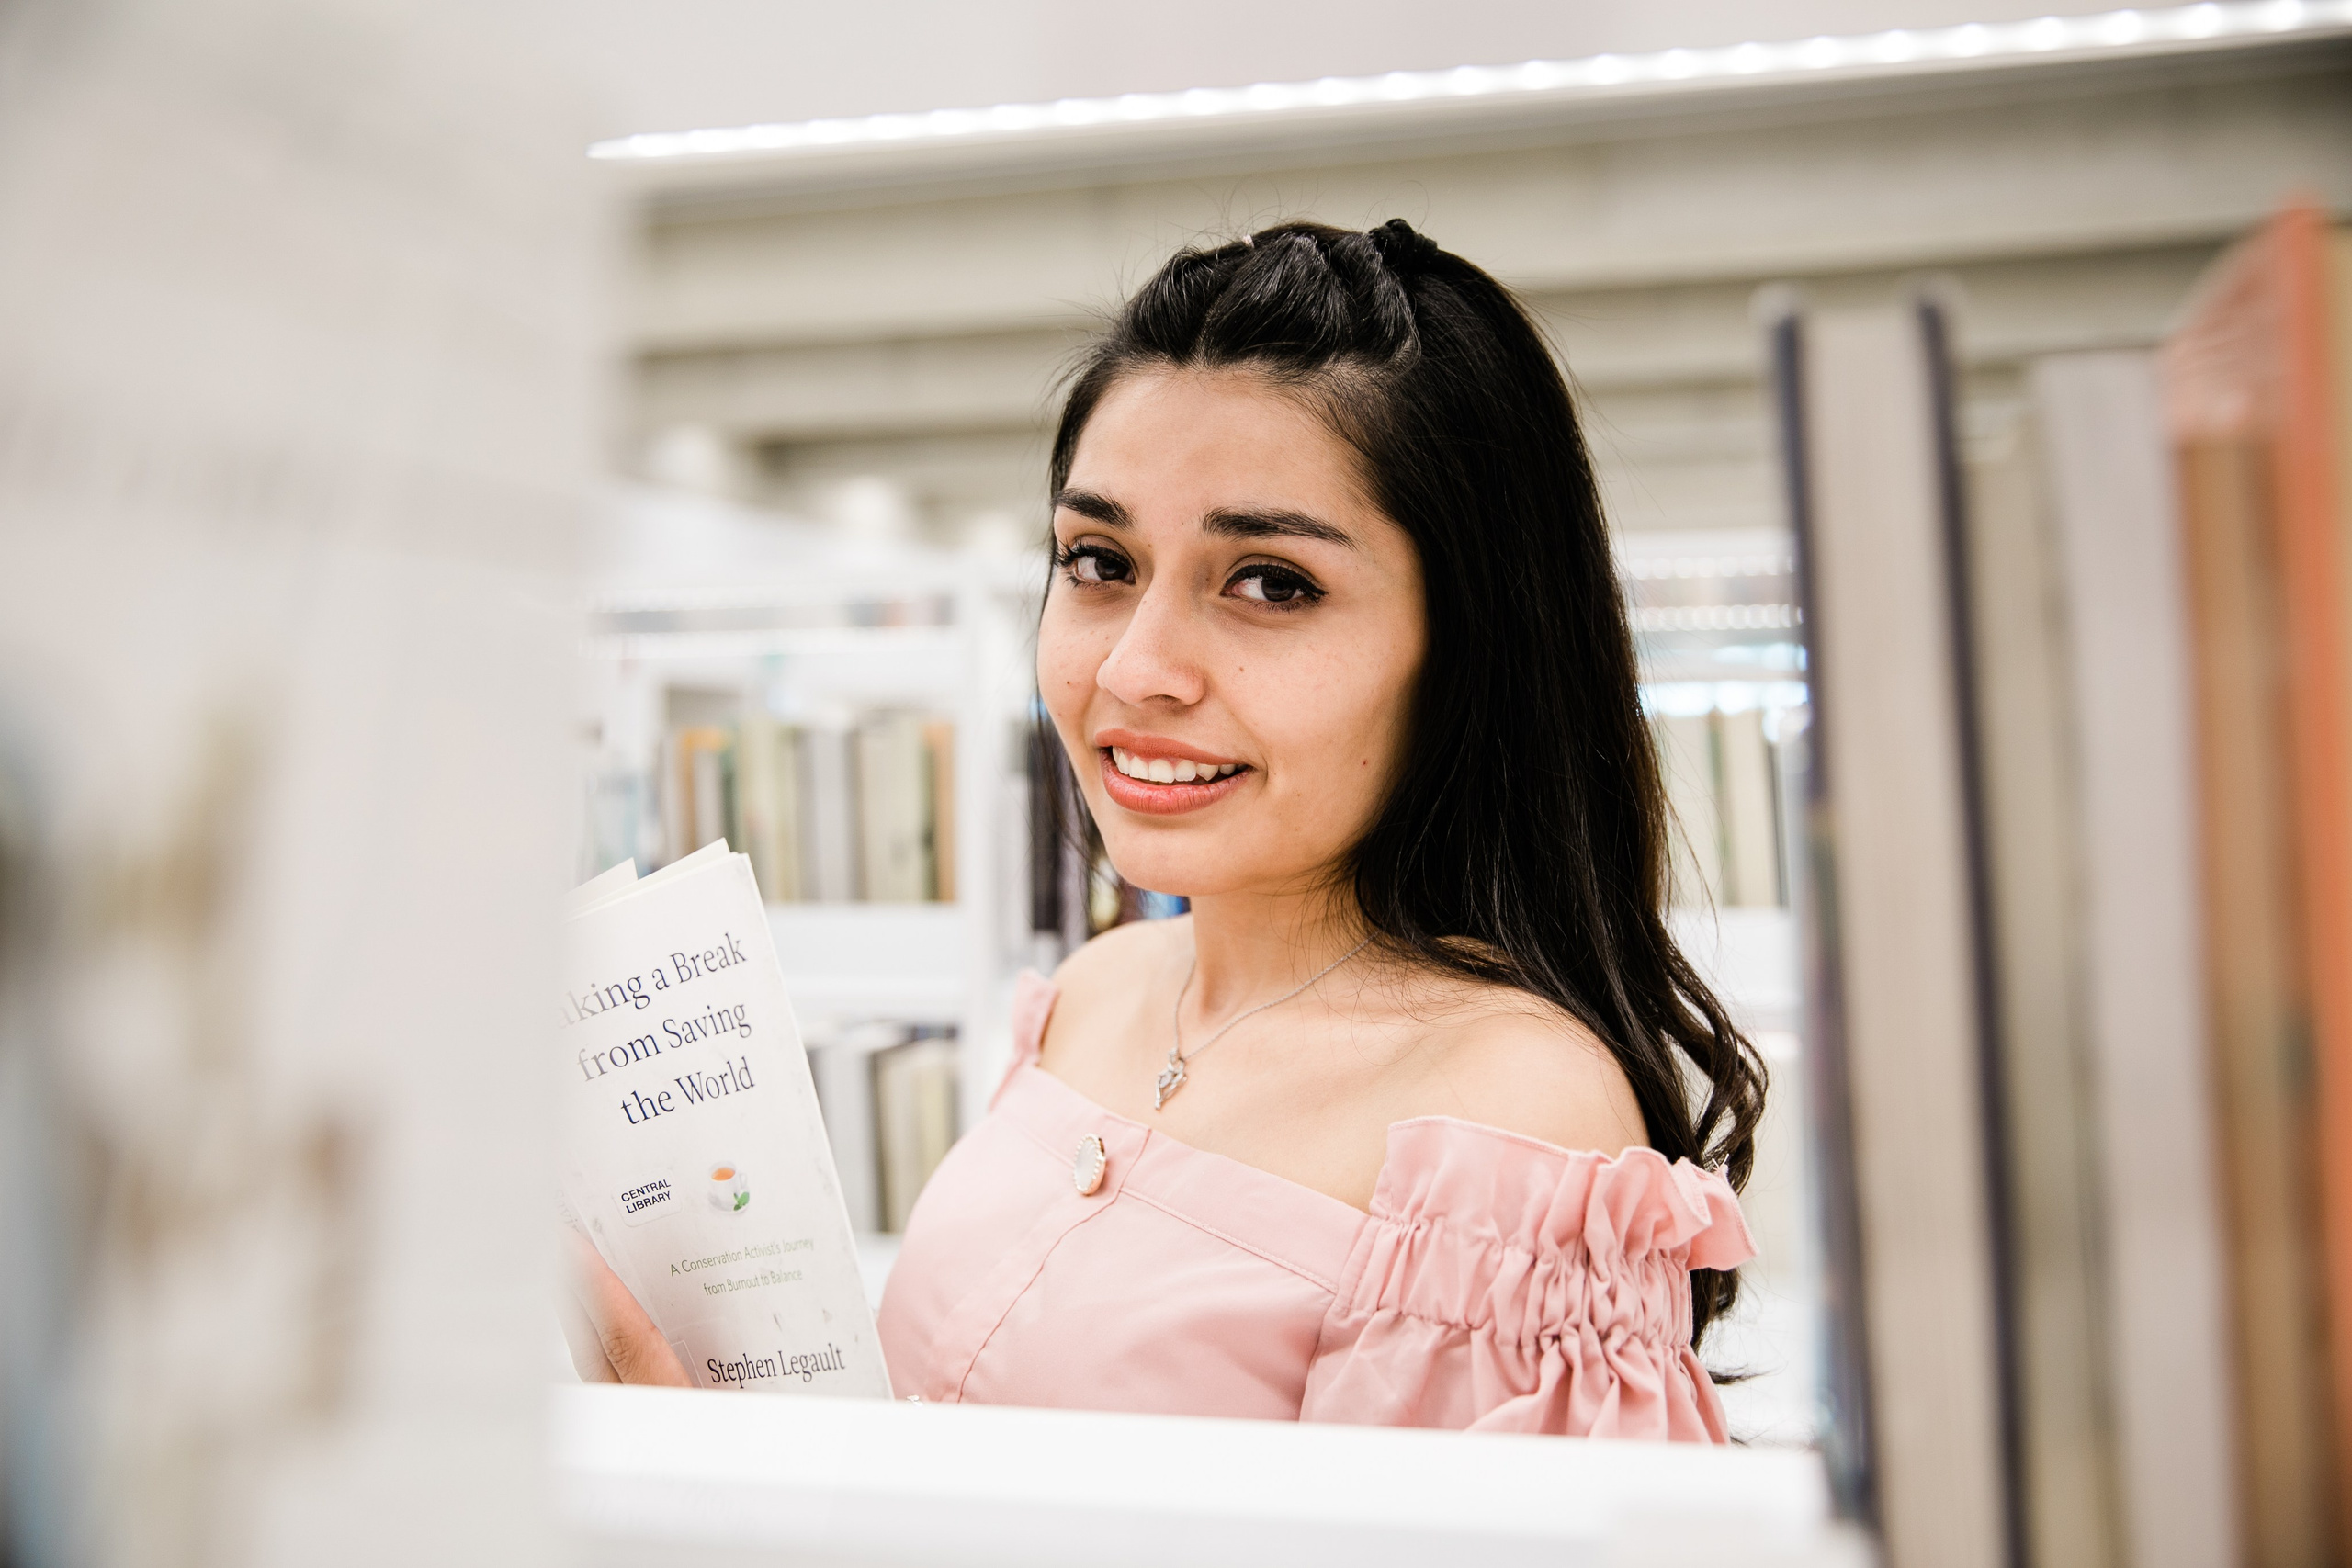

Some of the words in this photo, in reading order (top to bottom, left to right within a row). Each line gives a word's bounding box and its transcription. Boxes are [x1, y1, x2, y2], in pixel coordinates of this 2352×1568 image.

[651, 968, 670, 991] a
[669, 932, 747, 984] Break
[576, 1033, 662, 1082] from
[662, 1004, 752, 1048] Saving
[620, 1090, 675, 1125] the
[673, 1055, 755, 1105] World
[621, 1179, 672, 1202] CENTRAL
[626, 1190, 671, 1213] LIBRARY
[670, 1263, 681, 1277] A
[681, 1250, 743, 1273] Conservation
[744, 1242, 781, 1260] Activist's
[782, 1237, 814, 1253] Journey
[703, 1282, 727, 1296] from
[726, 1273, 760, 1292] Burnout
[761, 1274, 770, 1286] to
[770, 1269, 803, 1285] Balance
[707, 1352, 777, 1389] Stephen
[777, 1342, 846, 1383] Legault
